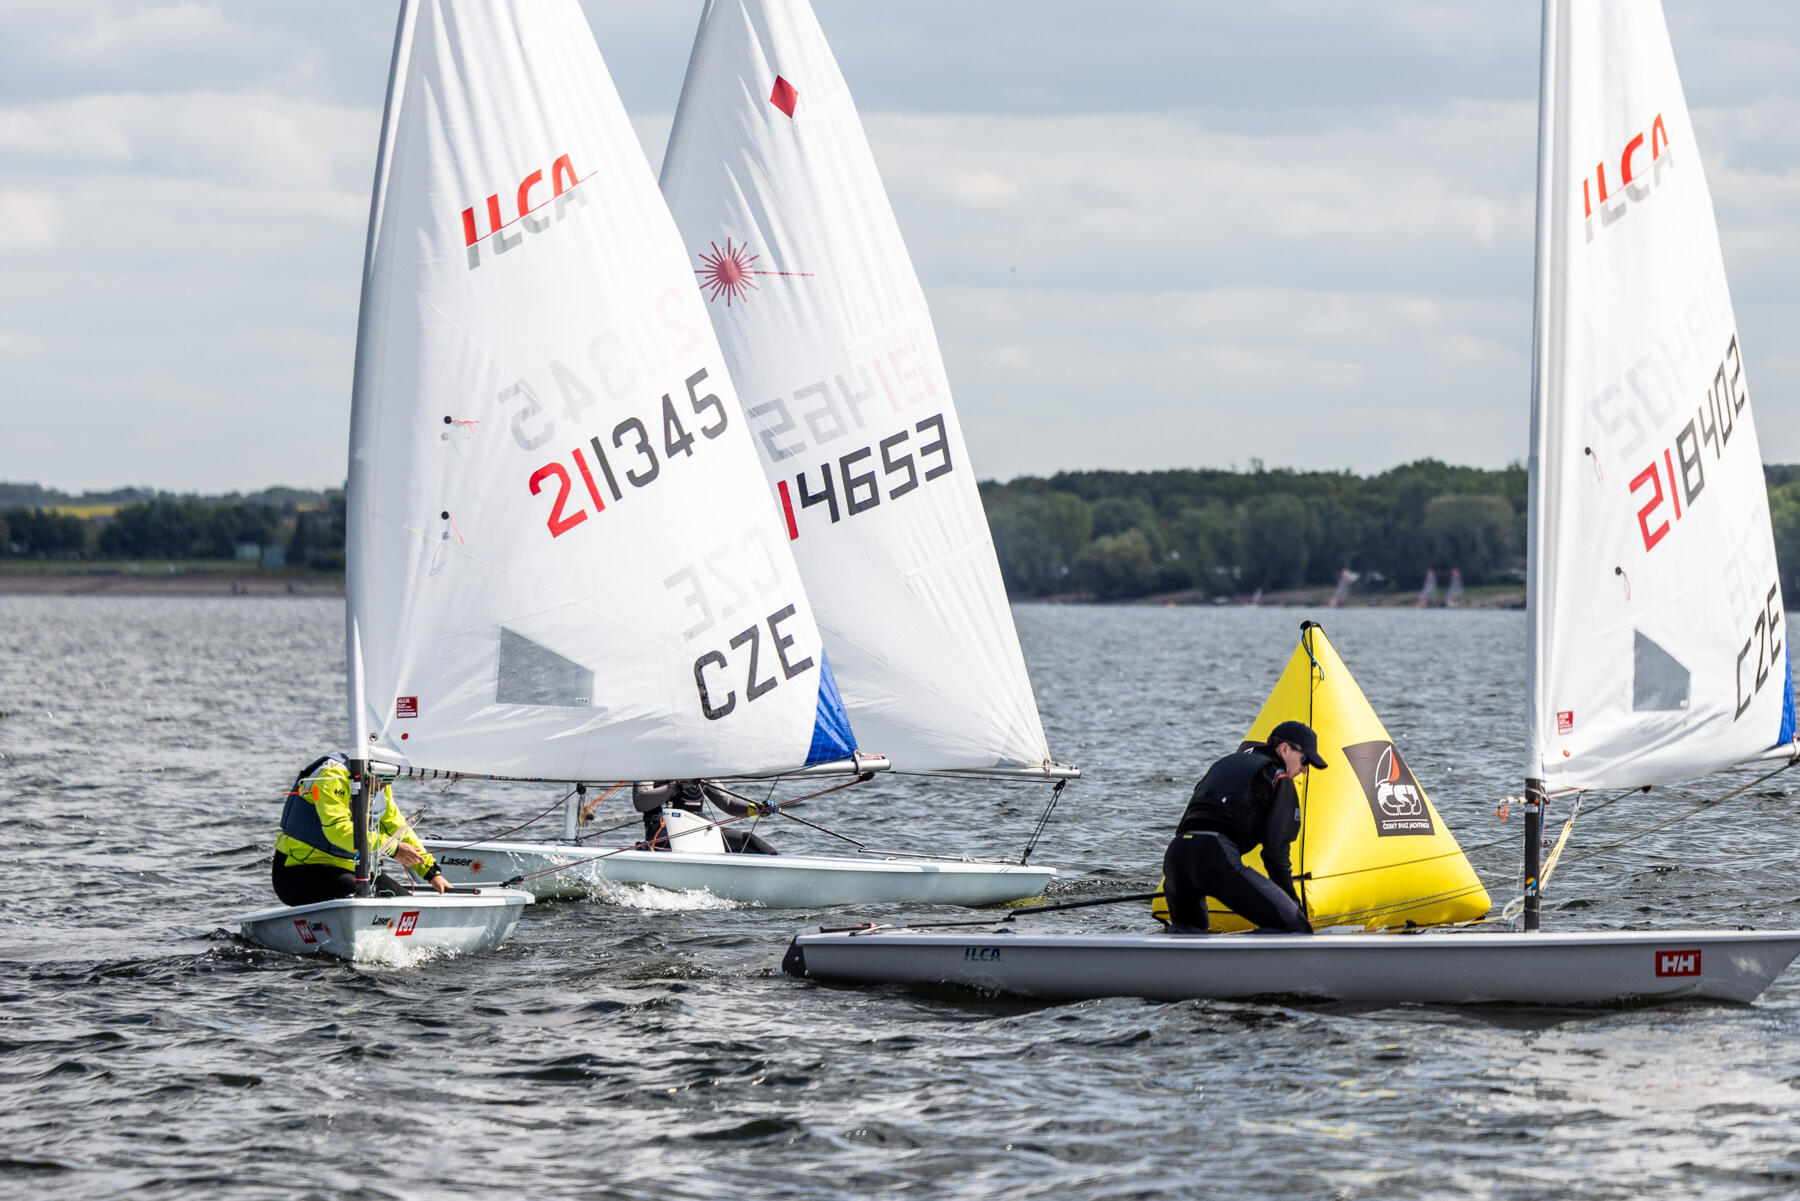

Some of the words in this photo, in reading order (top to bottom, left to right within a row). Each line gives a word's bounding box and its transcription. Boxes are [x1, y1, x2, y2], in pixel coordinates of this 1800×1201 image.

[461, 153, 588, 271] ILCA
[1583, 112, 1674, 245] ILCA
[528, 367, 728, 539] 211345
[777, 413, 954, 541] 14653
[1628, 333, 1745, 553] 218402
[693, 603, 814, 721] CZE
[1734, 583, 1782, 722] CZE
[440, 855, 472, 867] Laser
[371, 915, 391, 926] Laser
[964, 947, 1001, 962] ILCA
[1661, 954, 1695, 973] HH
